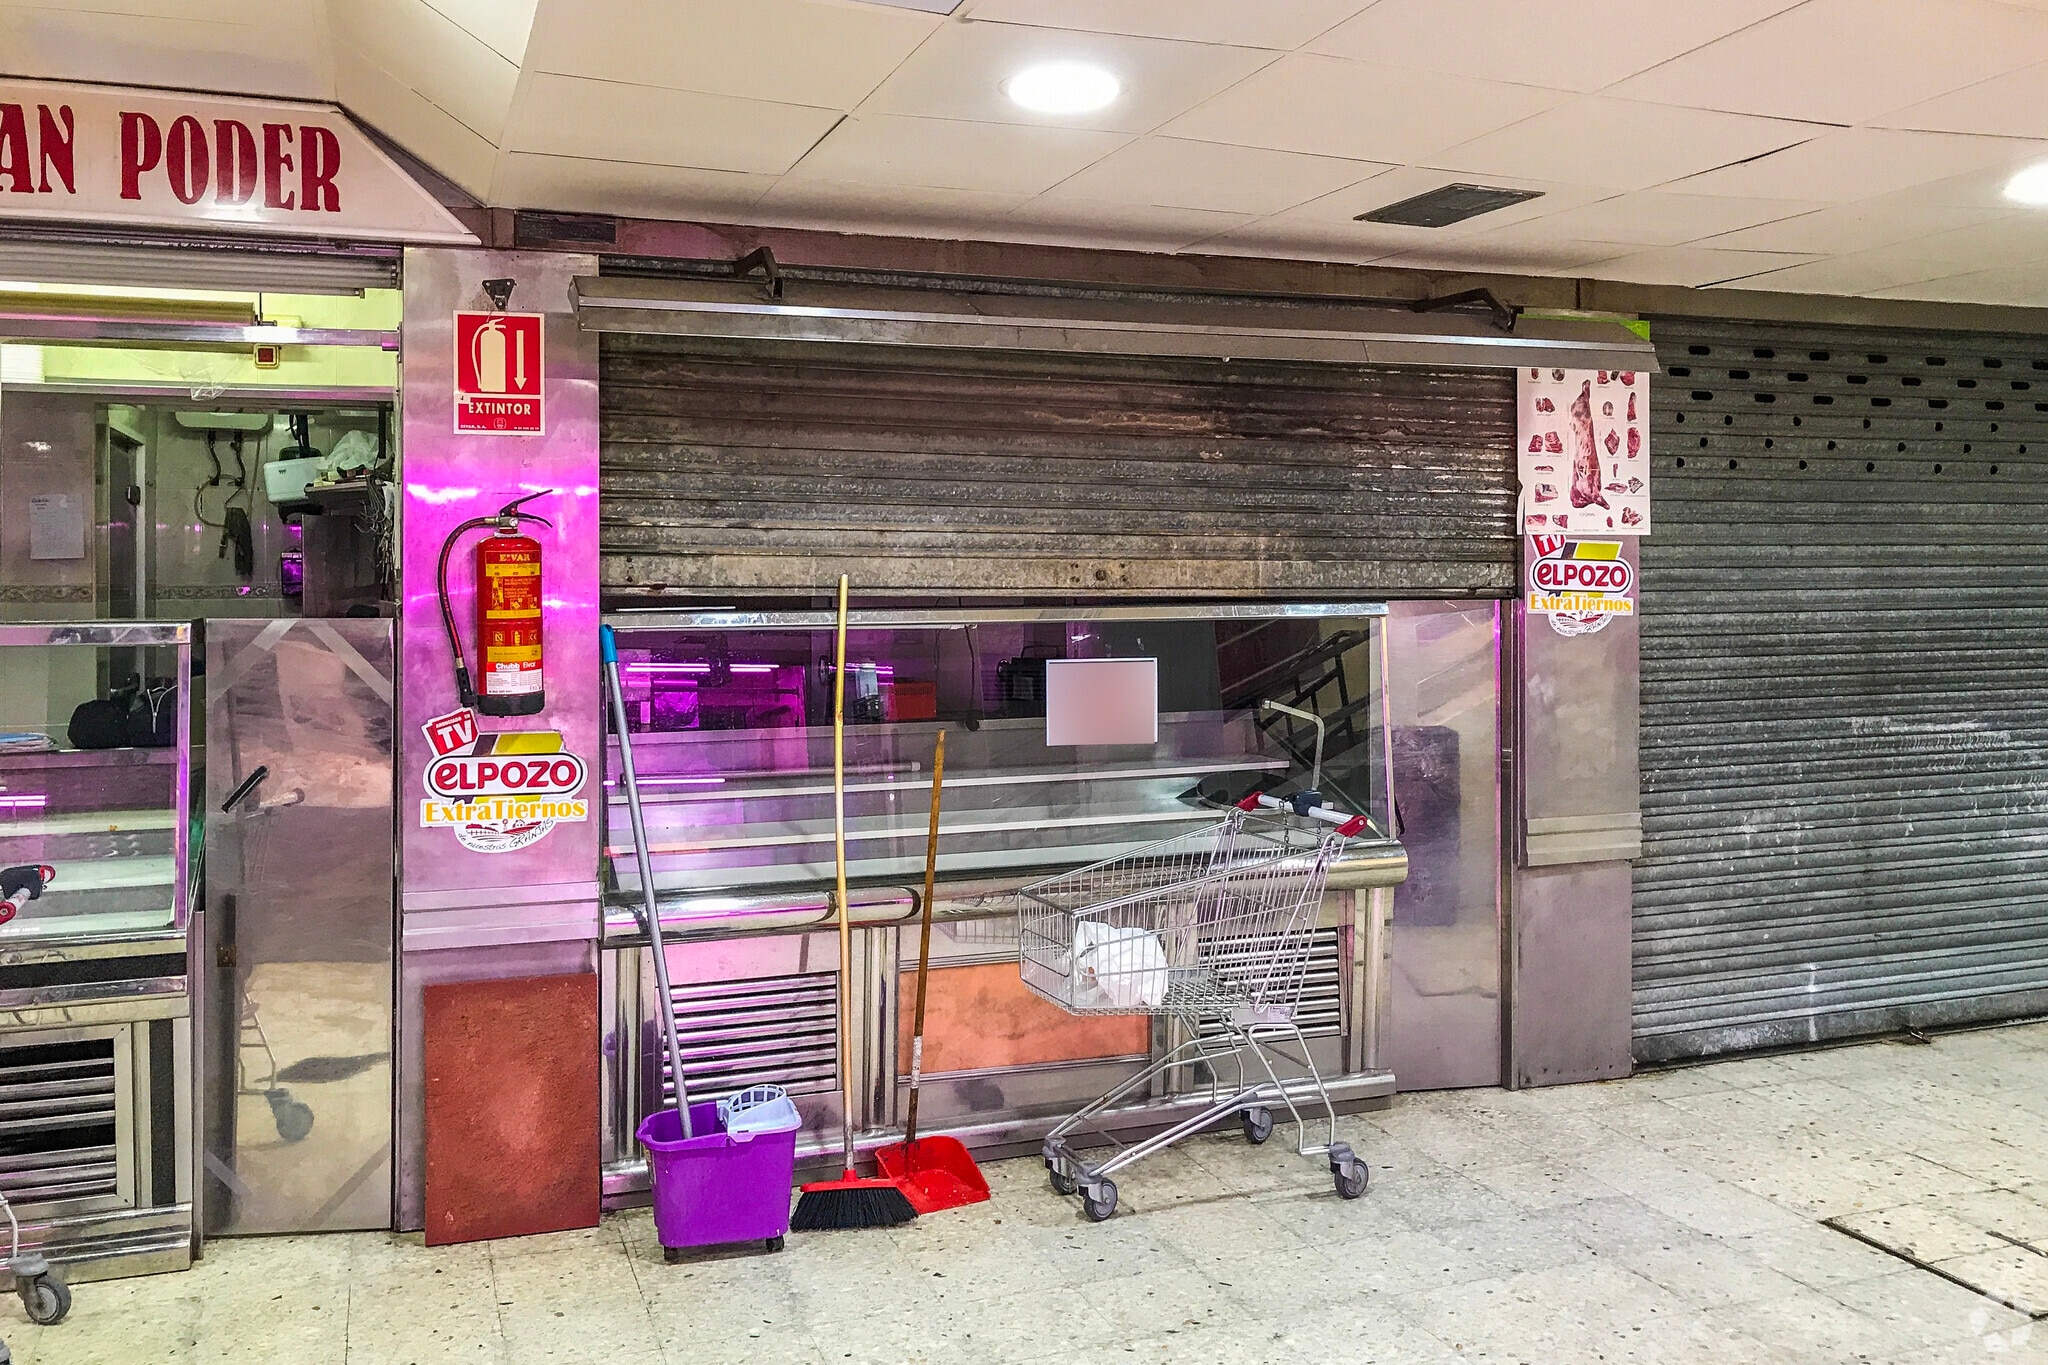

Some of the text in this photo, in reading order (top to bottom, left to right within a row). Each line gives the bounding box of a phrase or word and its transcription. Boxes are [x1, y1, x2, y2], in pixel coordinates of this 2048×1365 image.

[119, 111, 341, 212] PODER
[468, 402, 531, 415] EXTINTOR
[1539, 535, 1563, 552] TV
[437, 719, 473, 750] TV
[509, 817, 554, 848] GRANJAS
